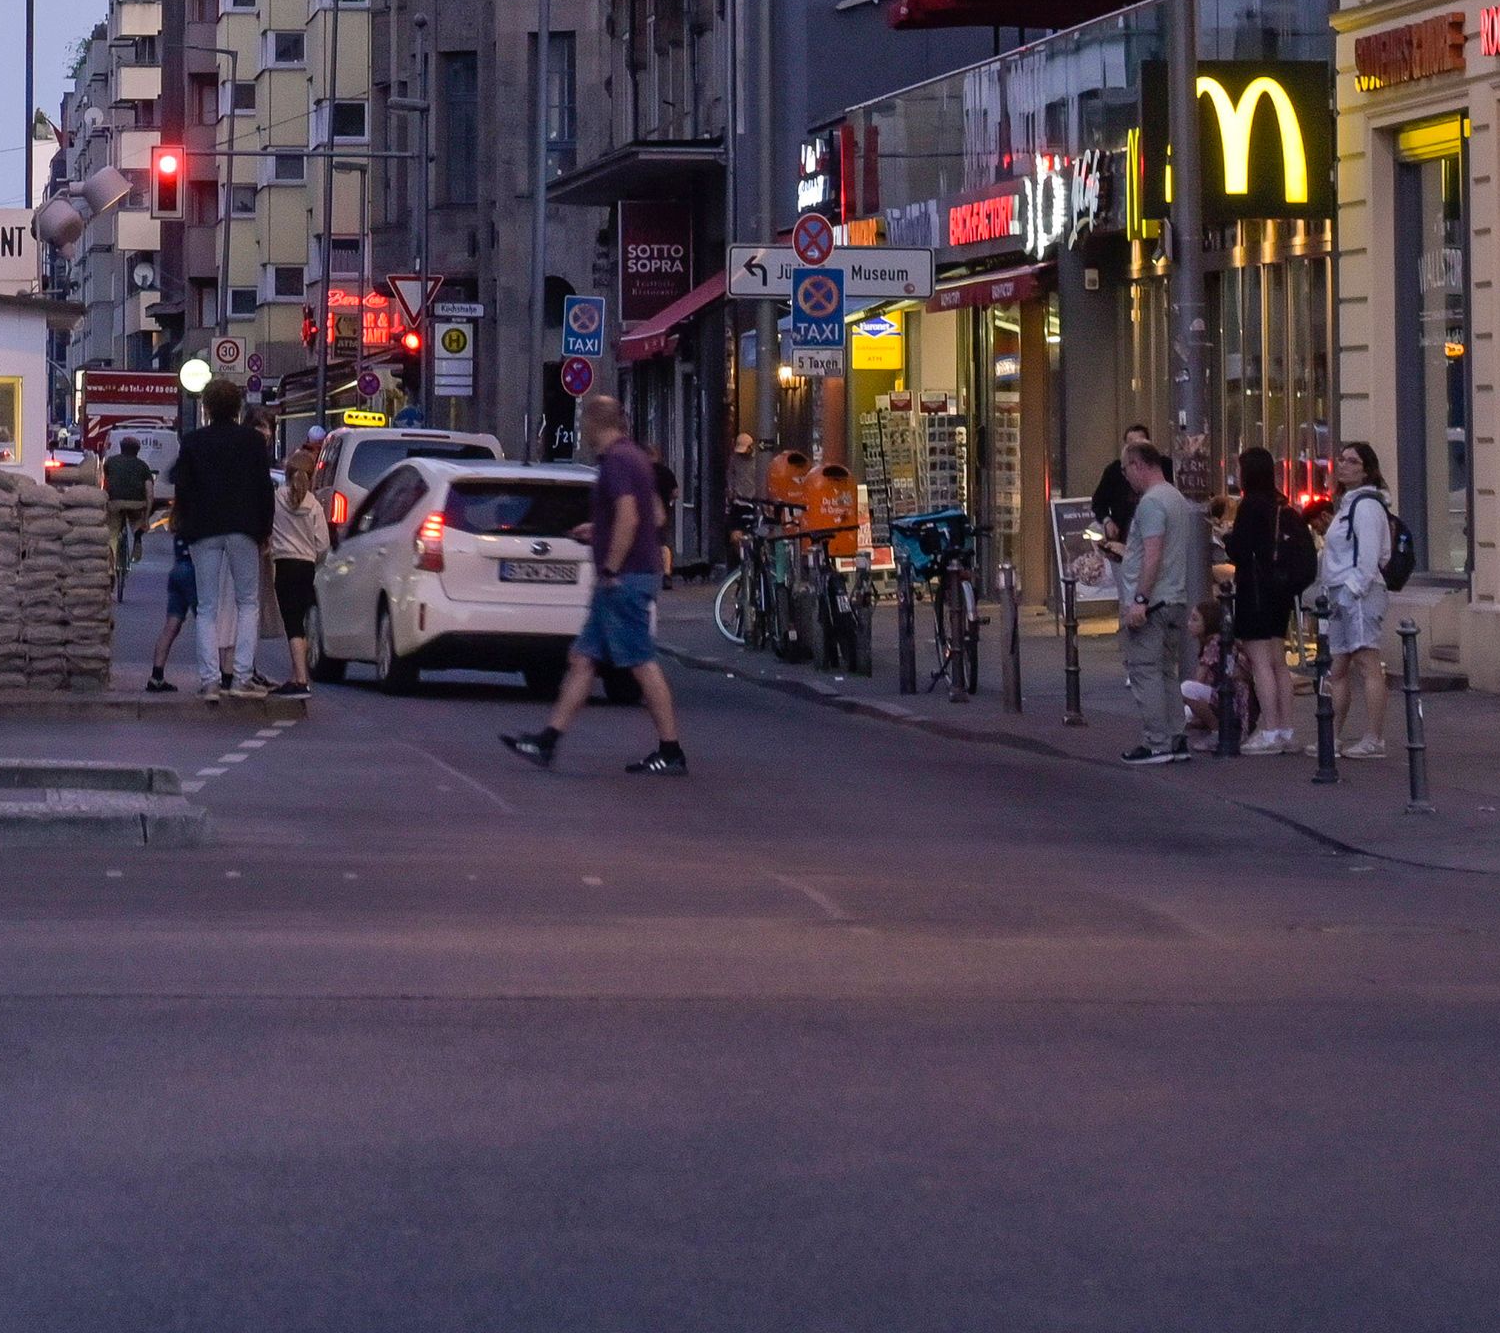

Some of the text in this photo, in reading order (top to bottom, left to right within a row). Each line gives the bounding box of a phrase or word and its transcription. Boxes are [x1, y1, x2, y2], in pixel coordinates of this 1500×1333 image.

[627, 244, 684, 258] SOTTO
[627, 259, 684, 273] SOPRA
[851, 264, 909, 282] Museum
[797, 323, 839, 341] TAXI
[568, 337, 599, 352] TAXI
[221, 346, 236, 358] 30
[218, 364, 237, 373] ZONE
[797, 356, 838, 369] 5 Taxen
